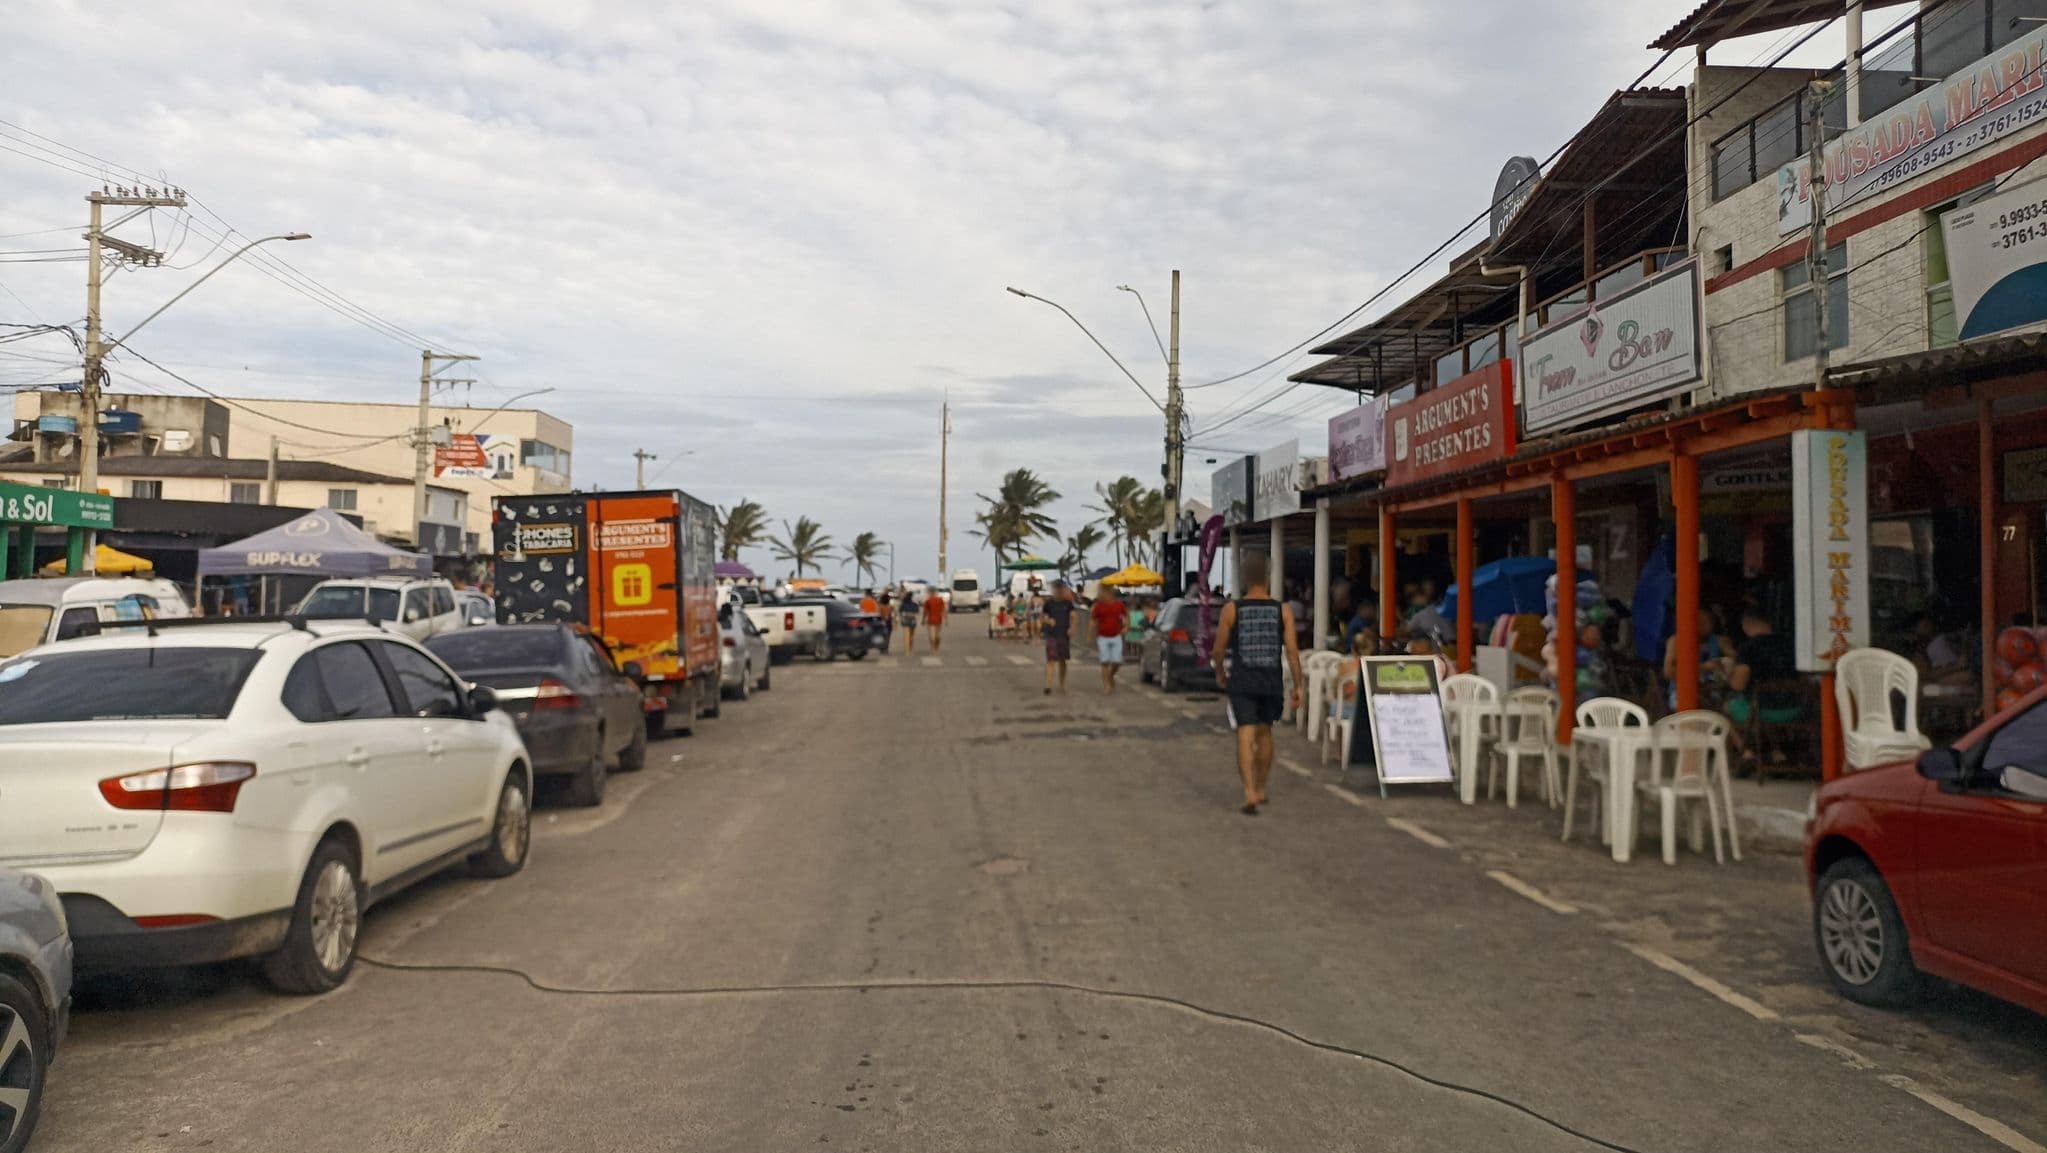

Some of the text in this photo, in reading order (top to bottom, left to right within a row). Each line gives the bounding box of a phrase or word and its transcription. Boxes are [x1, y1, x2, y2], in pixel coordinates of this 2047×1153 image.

[1943, 40, 2047, 132] MARI
[1881, 141, 1955, 186] 99608-9543
[1966, 133, 1978, 147] 27
[1414, 383, 1489, 436] ARGUMENT'S
[1415, 422, 1491, 467] PRESENTES
[8, 498, 20, 519] &
[23, 494, 53, 522] Sol
[596, 523, 666, 536] RGUMENT'S
[2002, 526, 2016, 541] 77
[1826, 551, 1853, 660] MARIMA
